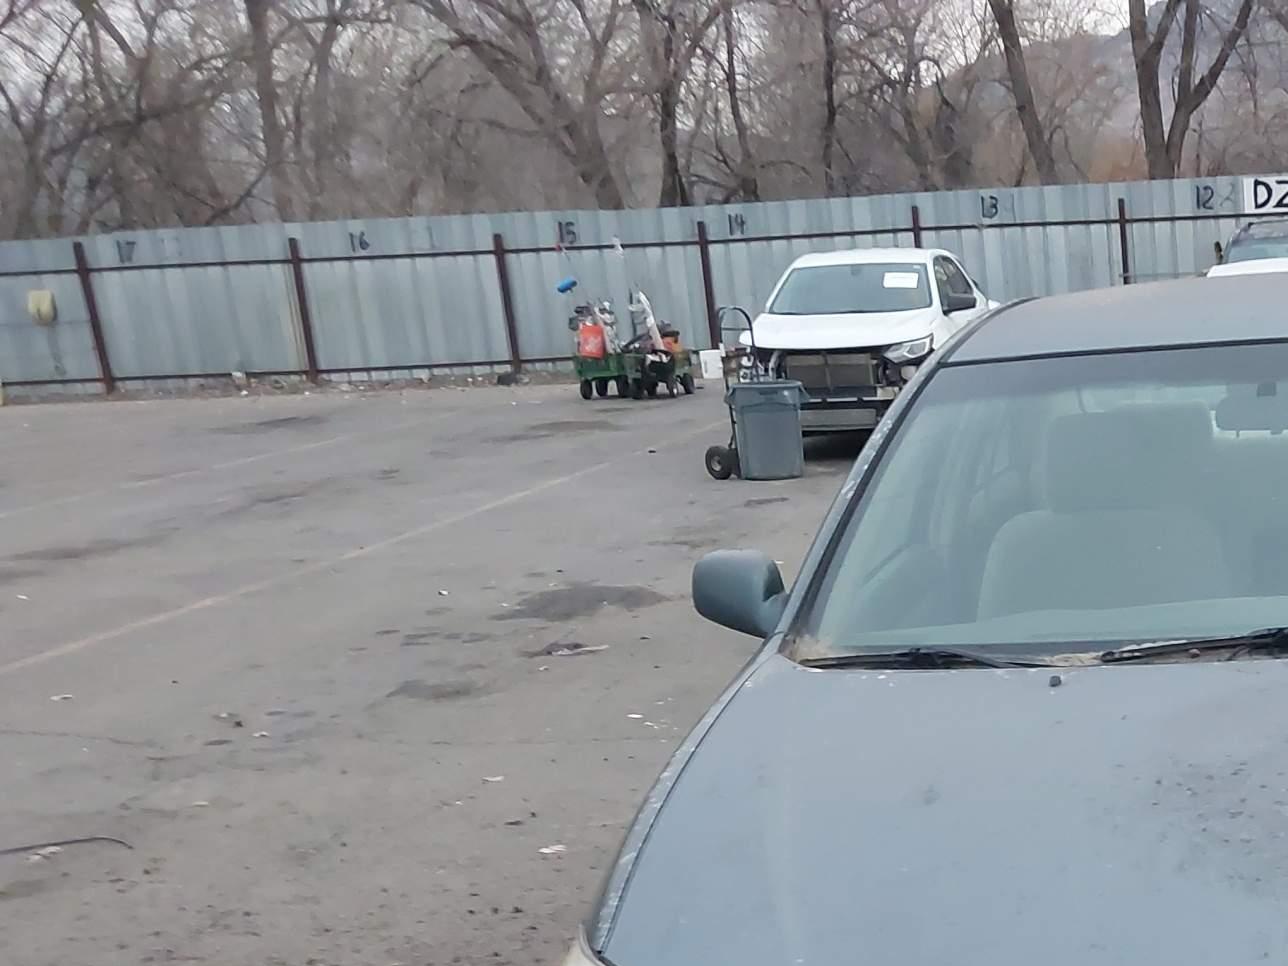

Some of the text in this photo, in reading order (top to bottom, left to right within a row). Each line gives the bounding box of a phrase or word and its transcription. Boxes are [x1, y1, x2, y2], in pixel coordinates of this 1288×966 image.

[980, 194, 999, 219] 13
[1195, 185, 1214, 210] 12
[557, 221, 577, 245] 15
[727, 213, 746, 236] 14
[348, 231, 370, 253] 16
